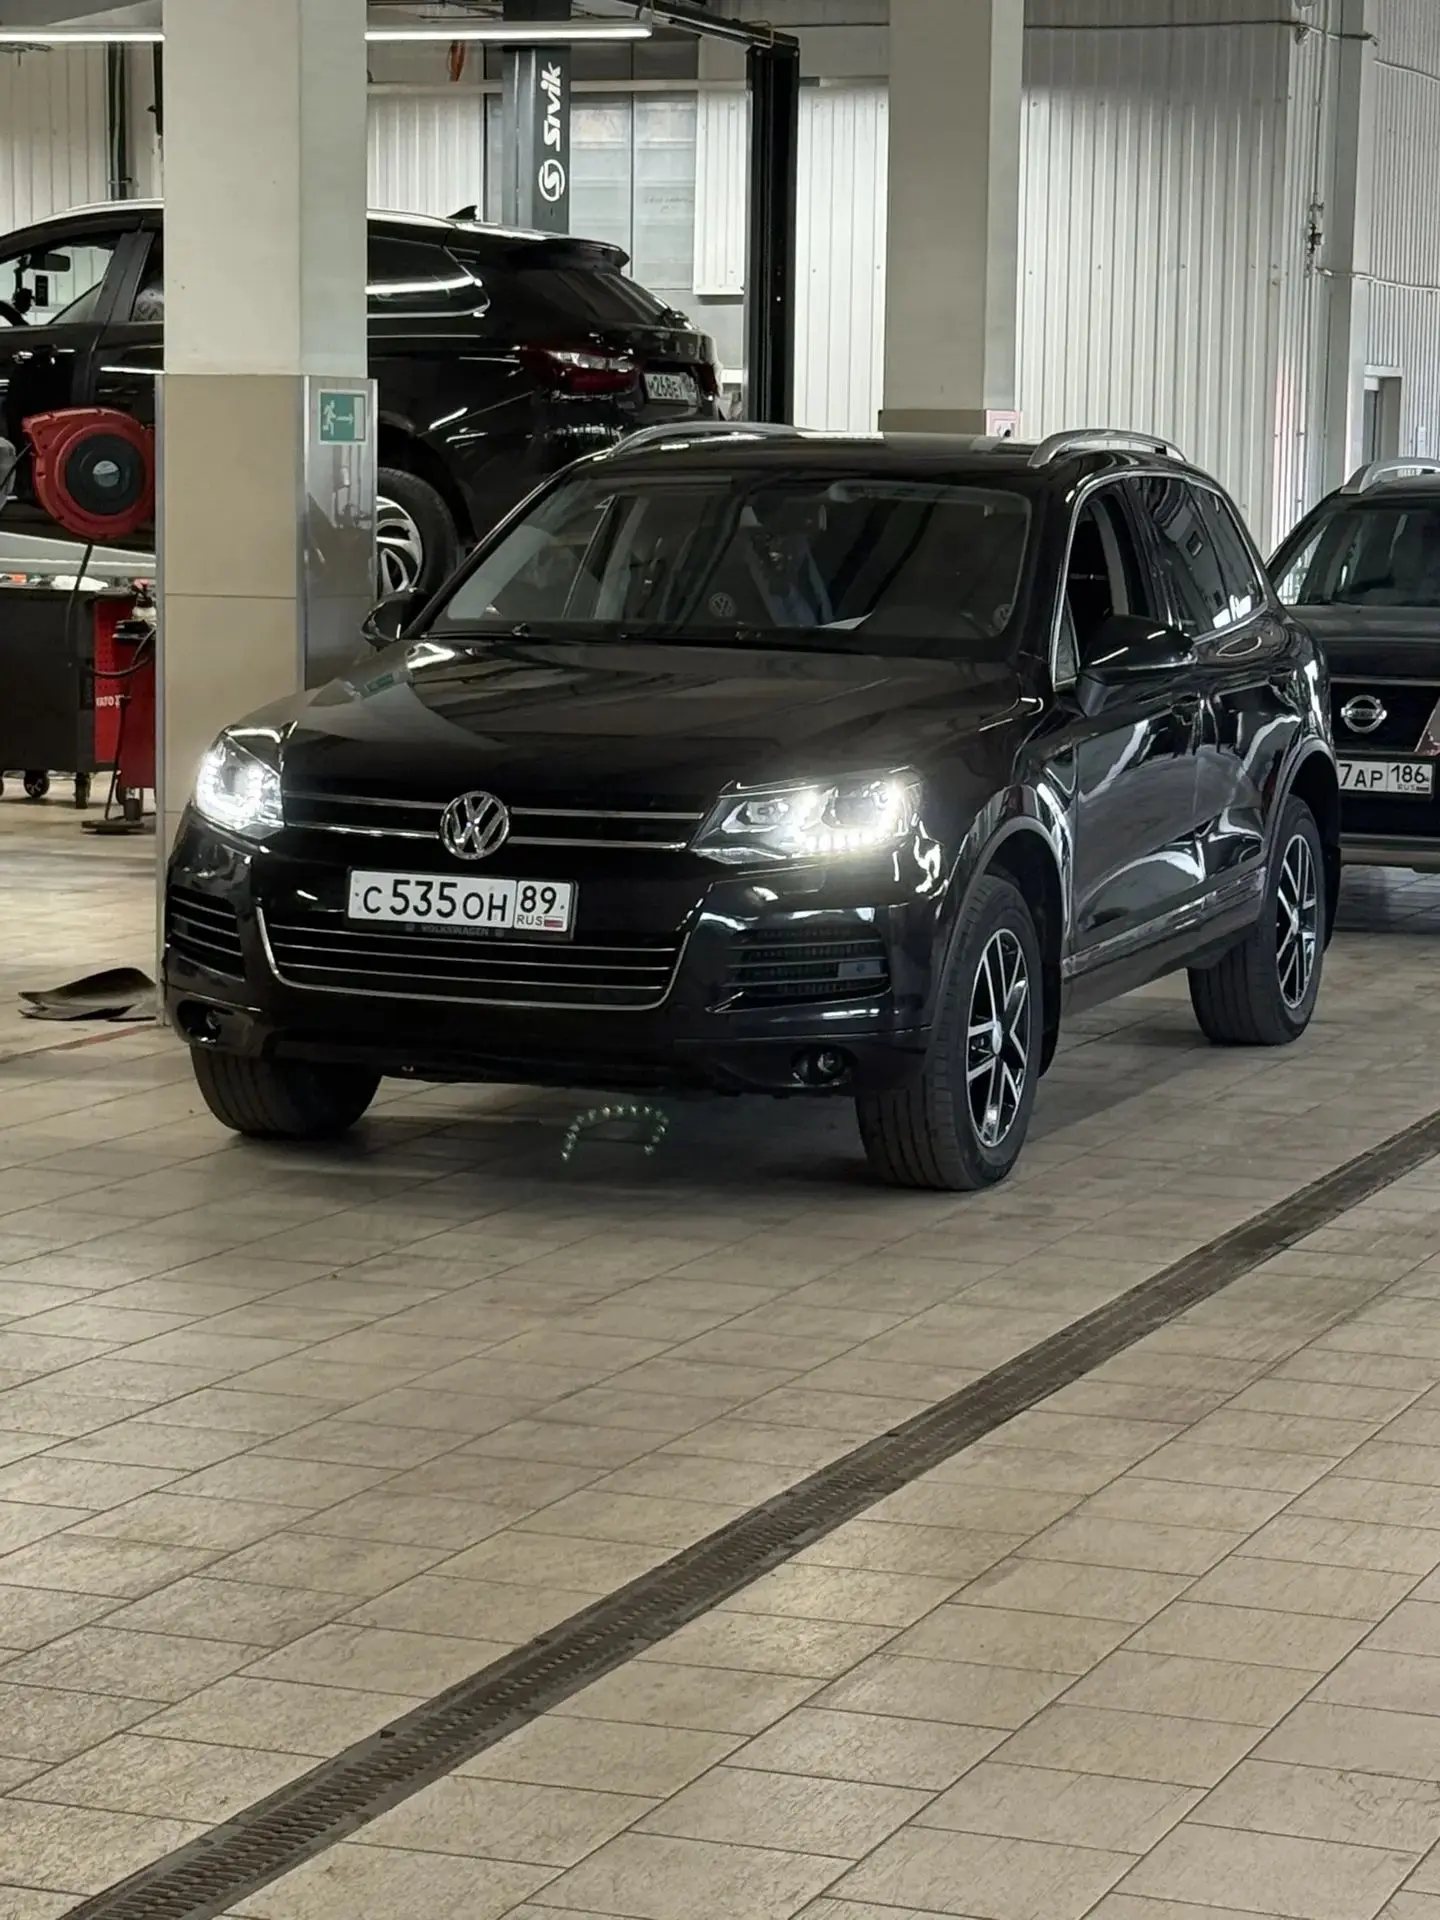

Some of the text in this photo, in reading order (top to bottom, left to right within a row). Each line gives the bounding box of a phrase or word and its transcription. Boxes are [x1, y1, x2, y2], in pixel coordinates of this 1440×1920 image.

[1390, 764, 1425, 784] 186
[519, 885, 557, 915] 89
[516, 914, 543, 927] RUS
